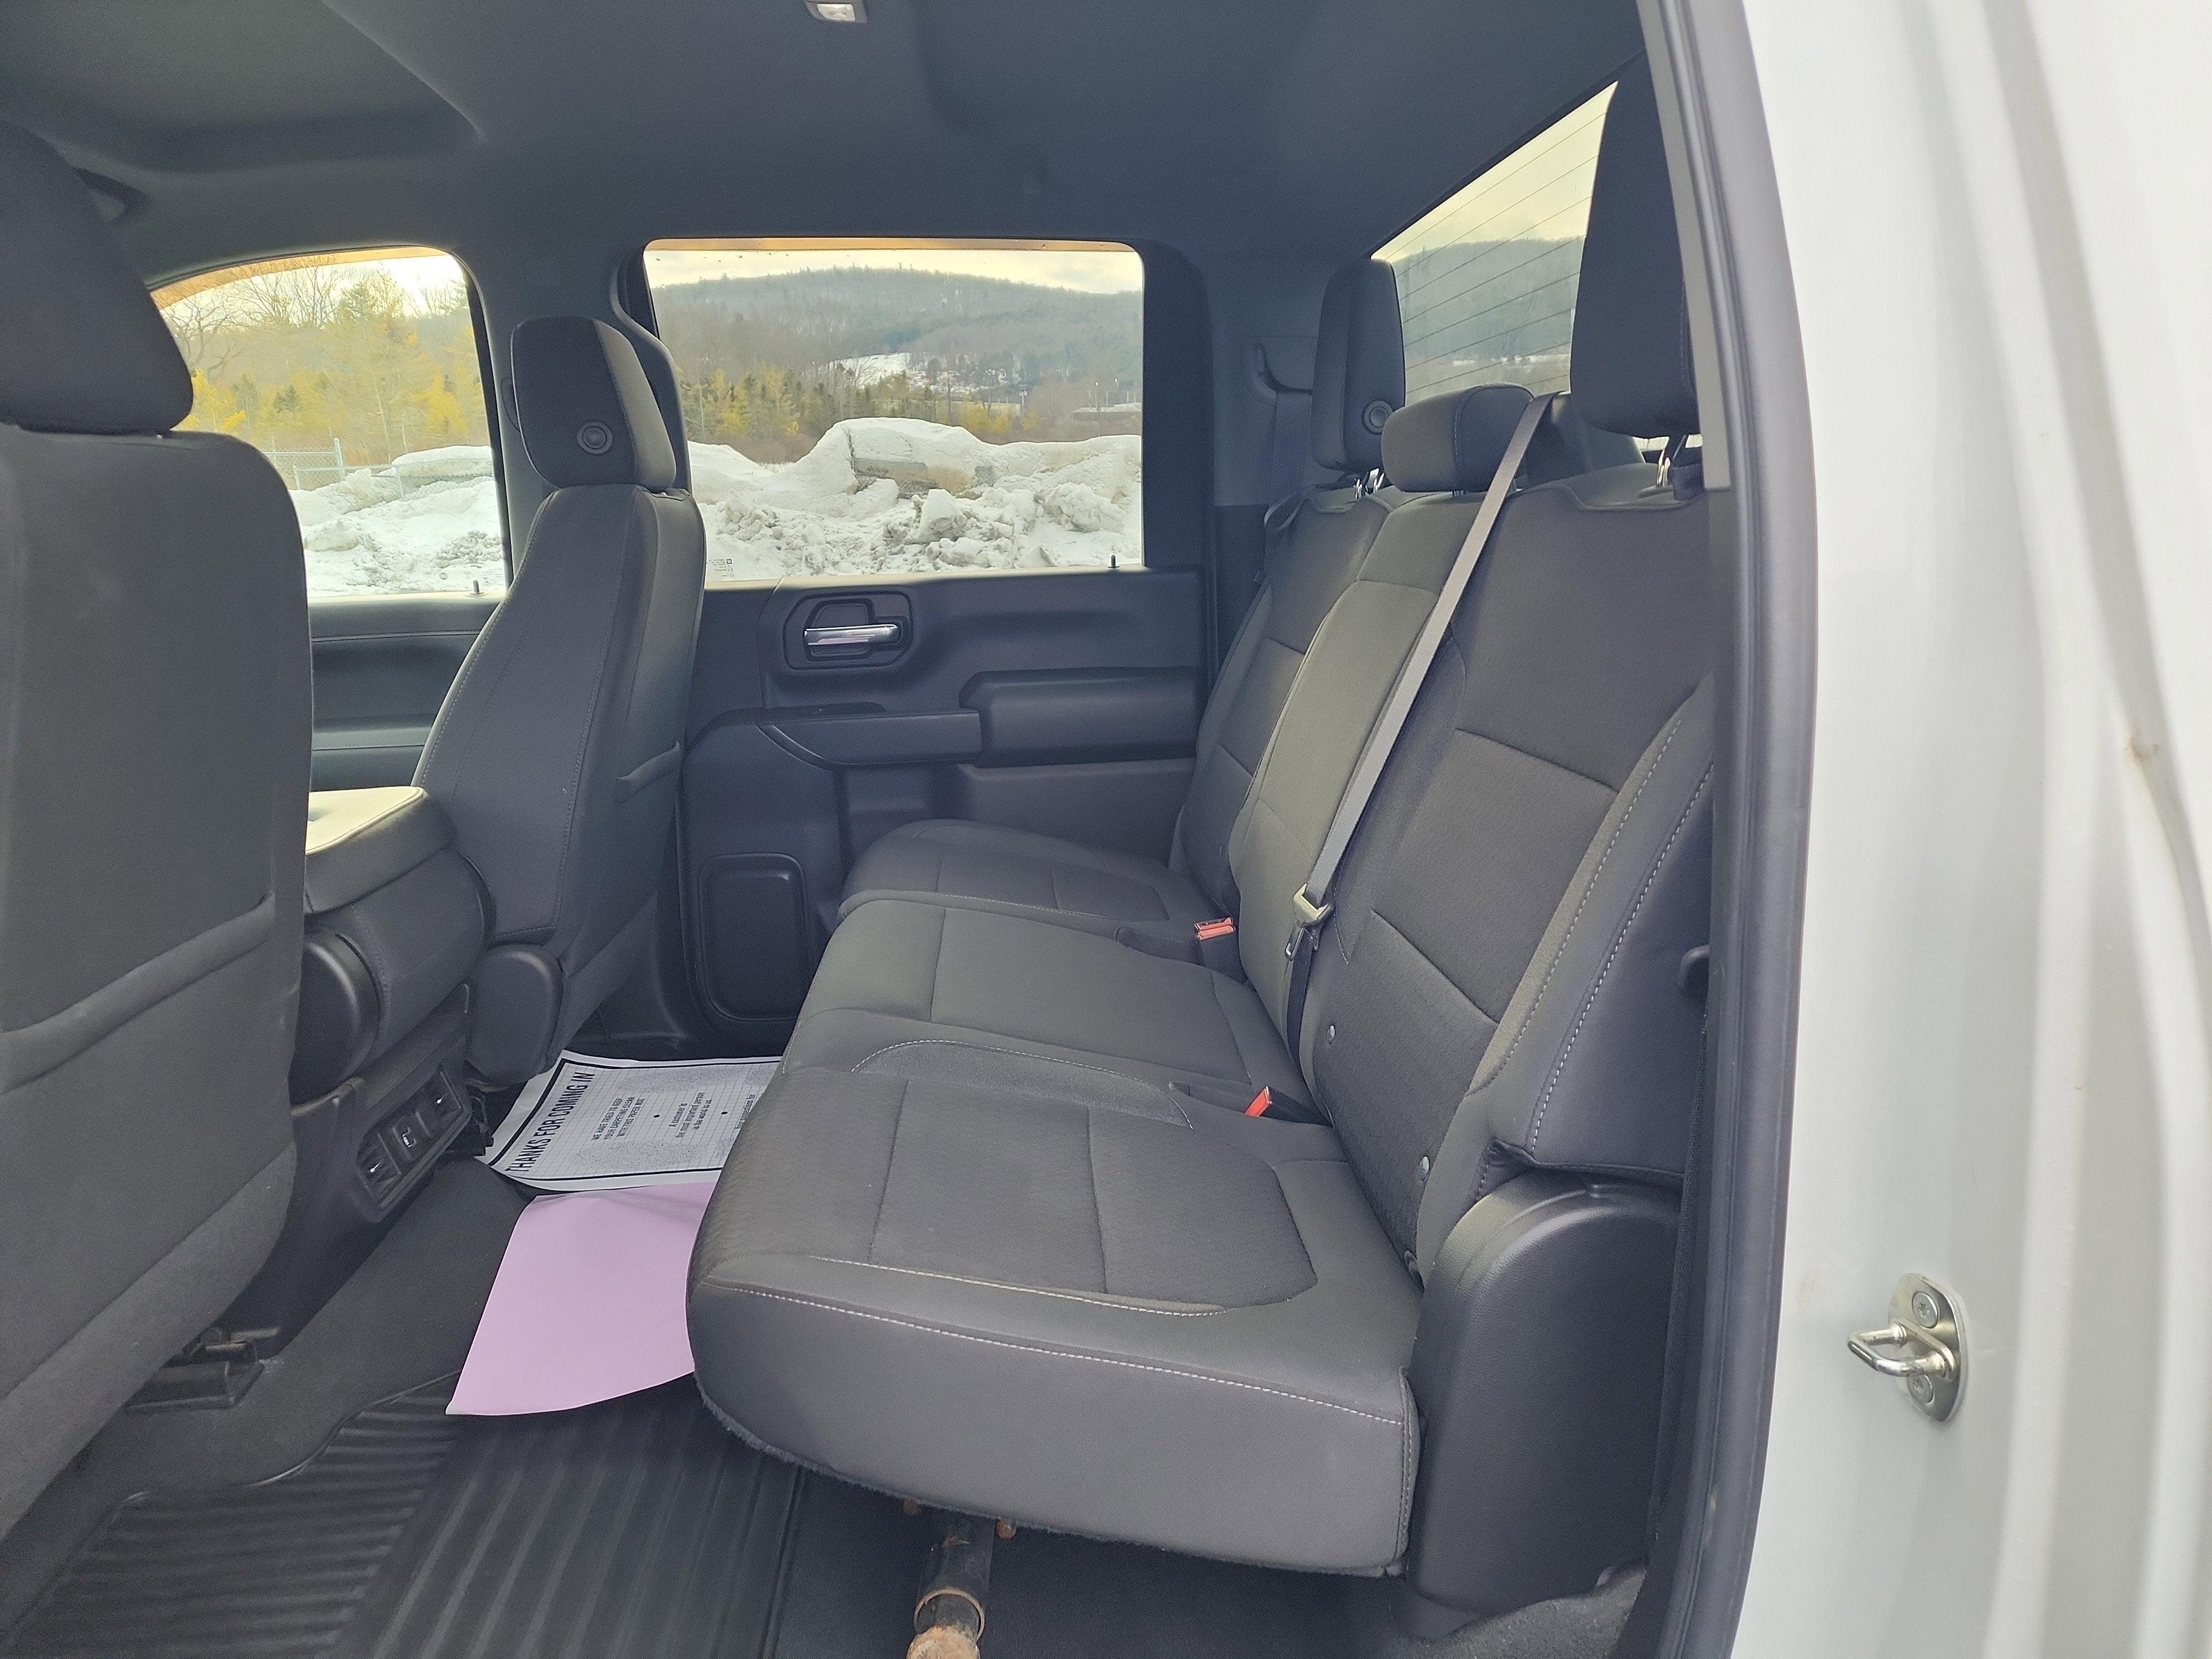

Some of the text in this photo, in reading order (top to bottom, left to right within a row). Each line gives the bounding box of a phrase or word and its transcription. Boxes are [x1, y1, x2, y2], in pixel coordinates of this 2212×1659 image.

[504, 1072, 596, 1171] THANKS FOR COMING IN
[602, 1097, 635, 1139] YOUR CARPETING CLEAN
[671, 1107, 685, 1123] customer
[684, 1105, 699, 1121] important
[692, 1092, 705, 1104] person
